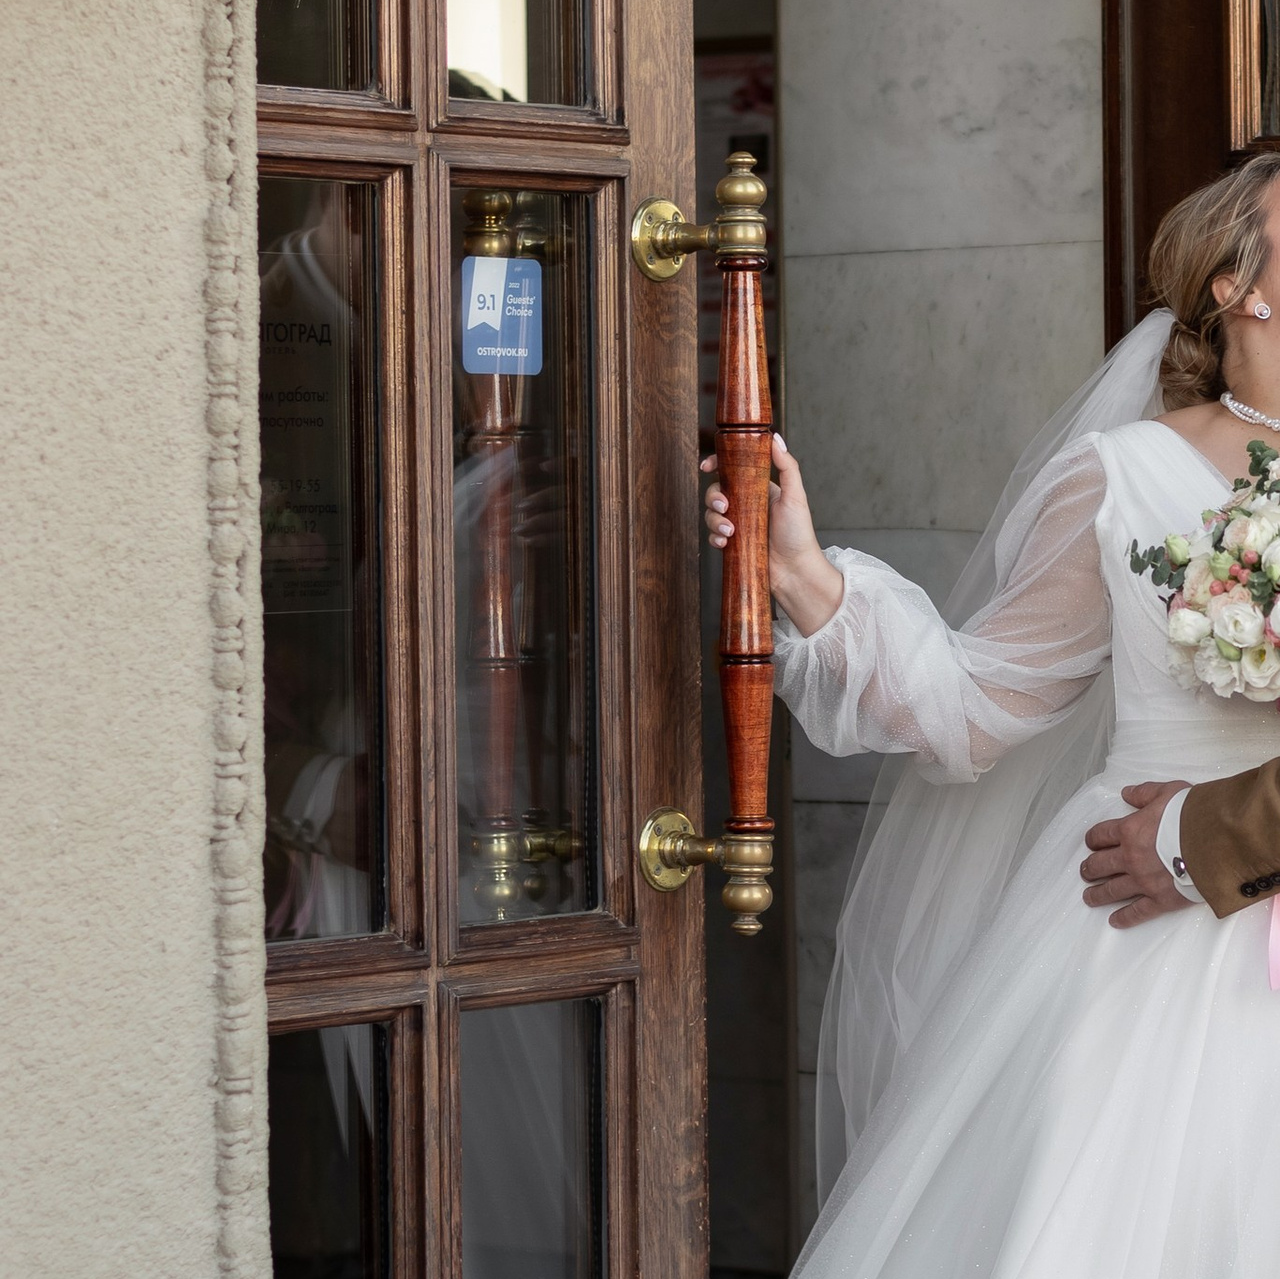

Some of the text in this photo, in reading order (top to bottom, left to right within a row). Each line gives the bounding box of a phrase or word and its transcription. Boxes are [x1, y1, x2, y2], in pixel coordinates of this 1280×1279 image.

[477, 293, 496, 310] 9.1
[505, 306, 533, 317] Choice
[477, 346, 529, 358] OSTROVOK.RU
